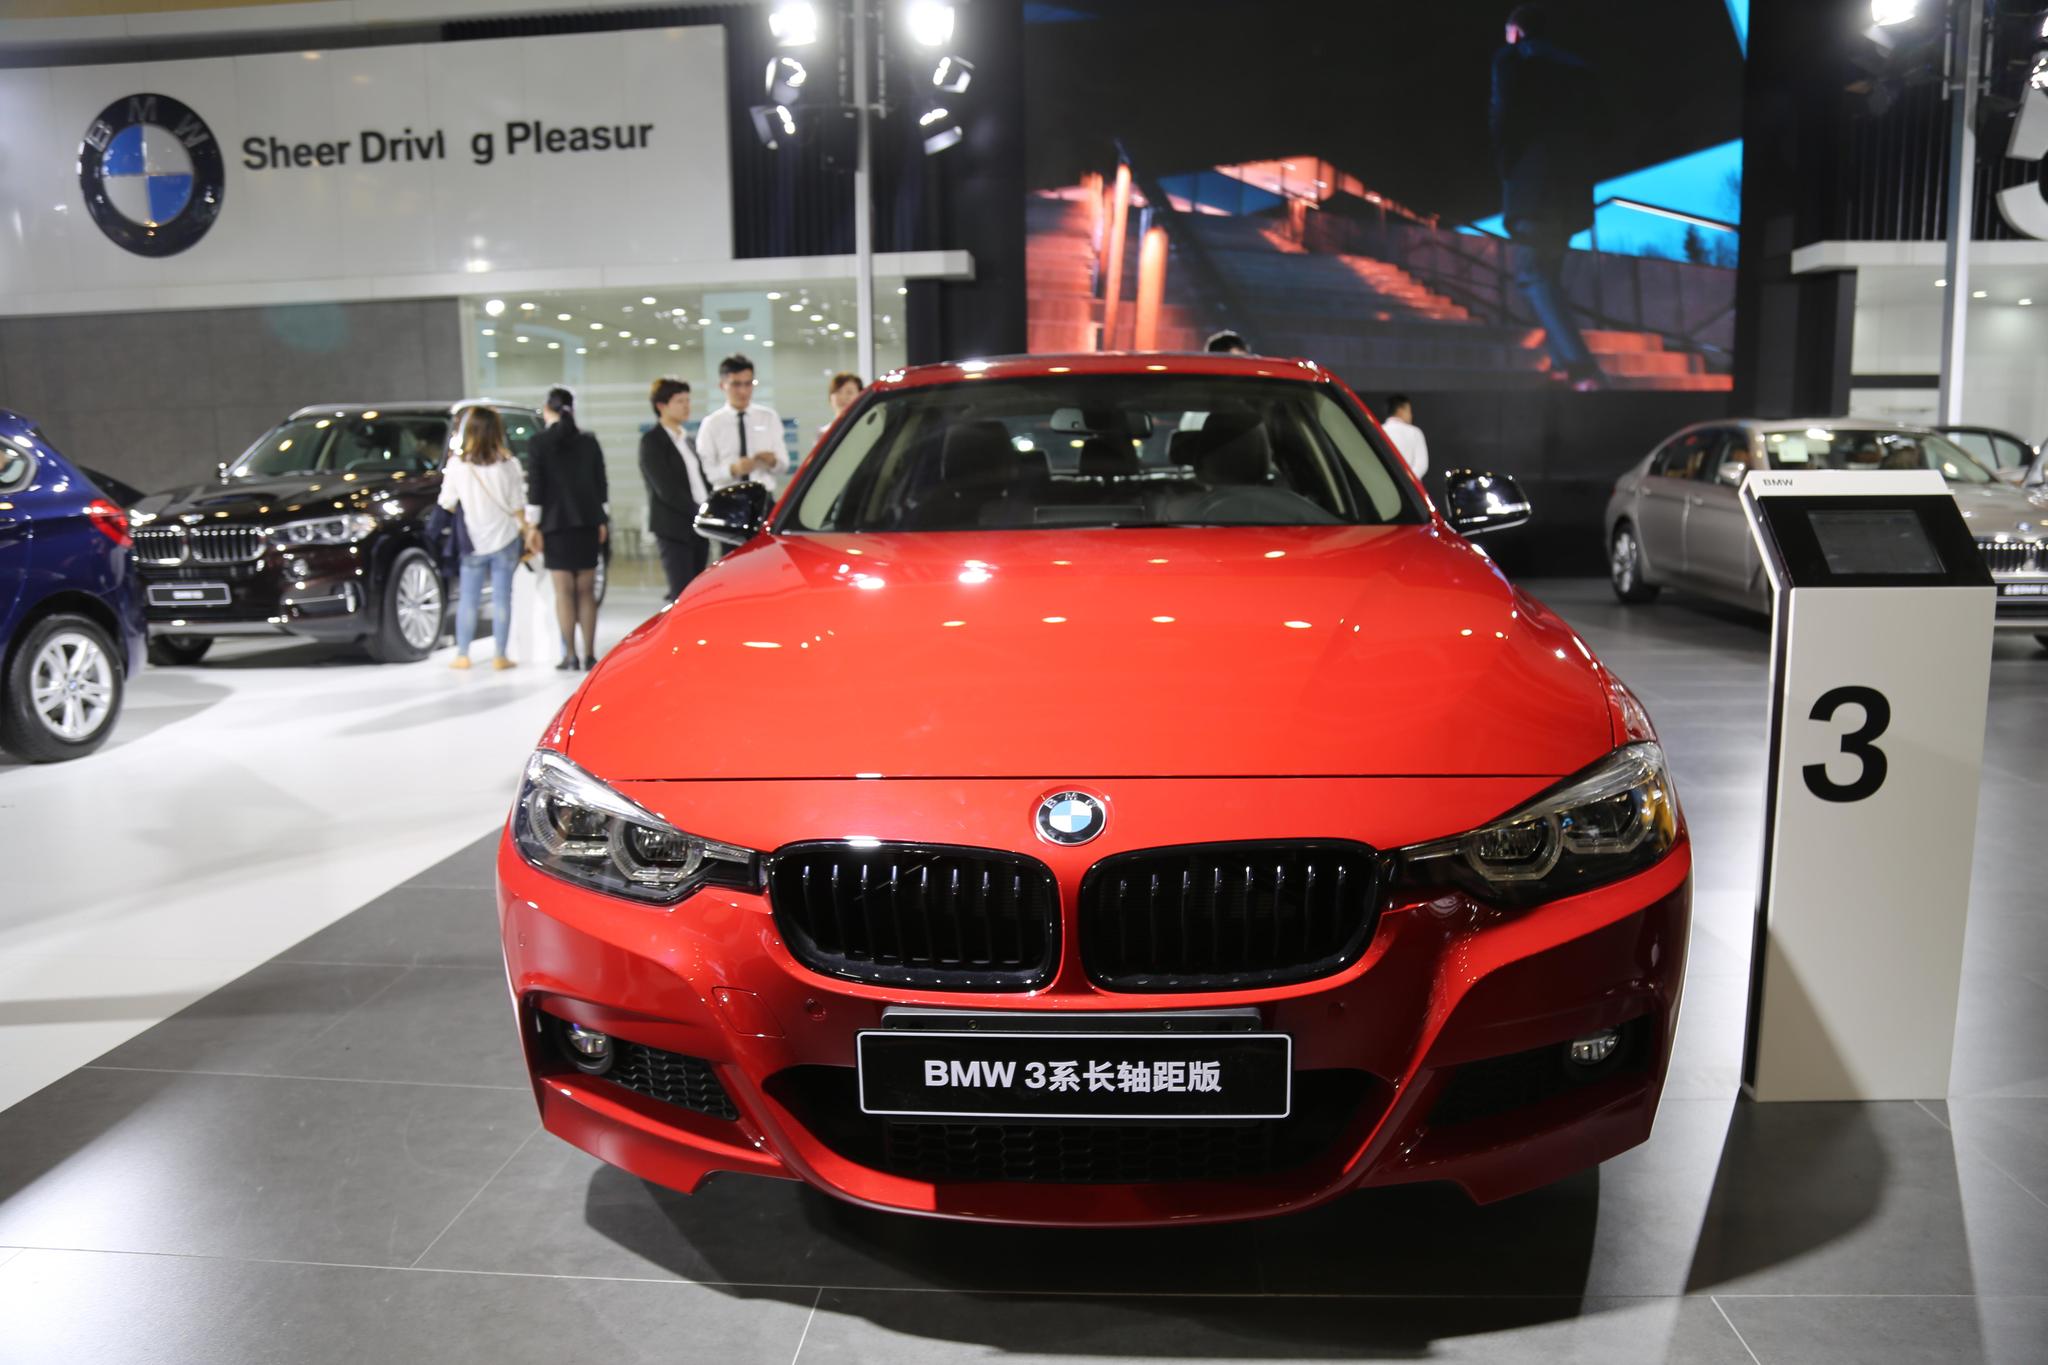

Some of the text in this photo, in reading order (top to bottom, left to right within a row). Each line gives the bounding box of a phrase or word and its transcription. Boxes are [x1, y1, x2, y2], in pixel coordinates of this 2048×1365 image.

[84, 96, 210, 152] BMW
[242, 136, 351, 170] Sheer
[506, 120, 653, 155] Pleasur
[1762, 478, 1793, 487] BMW
[1802, 685, 1891, 803] 3
[924, 1059, 1223, 1093] BMW 3系长轴距版
